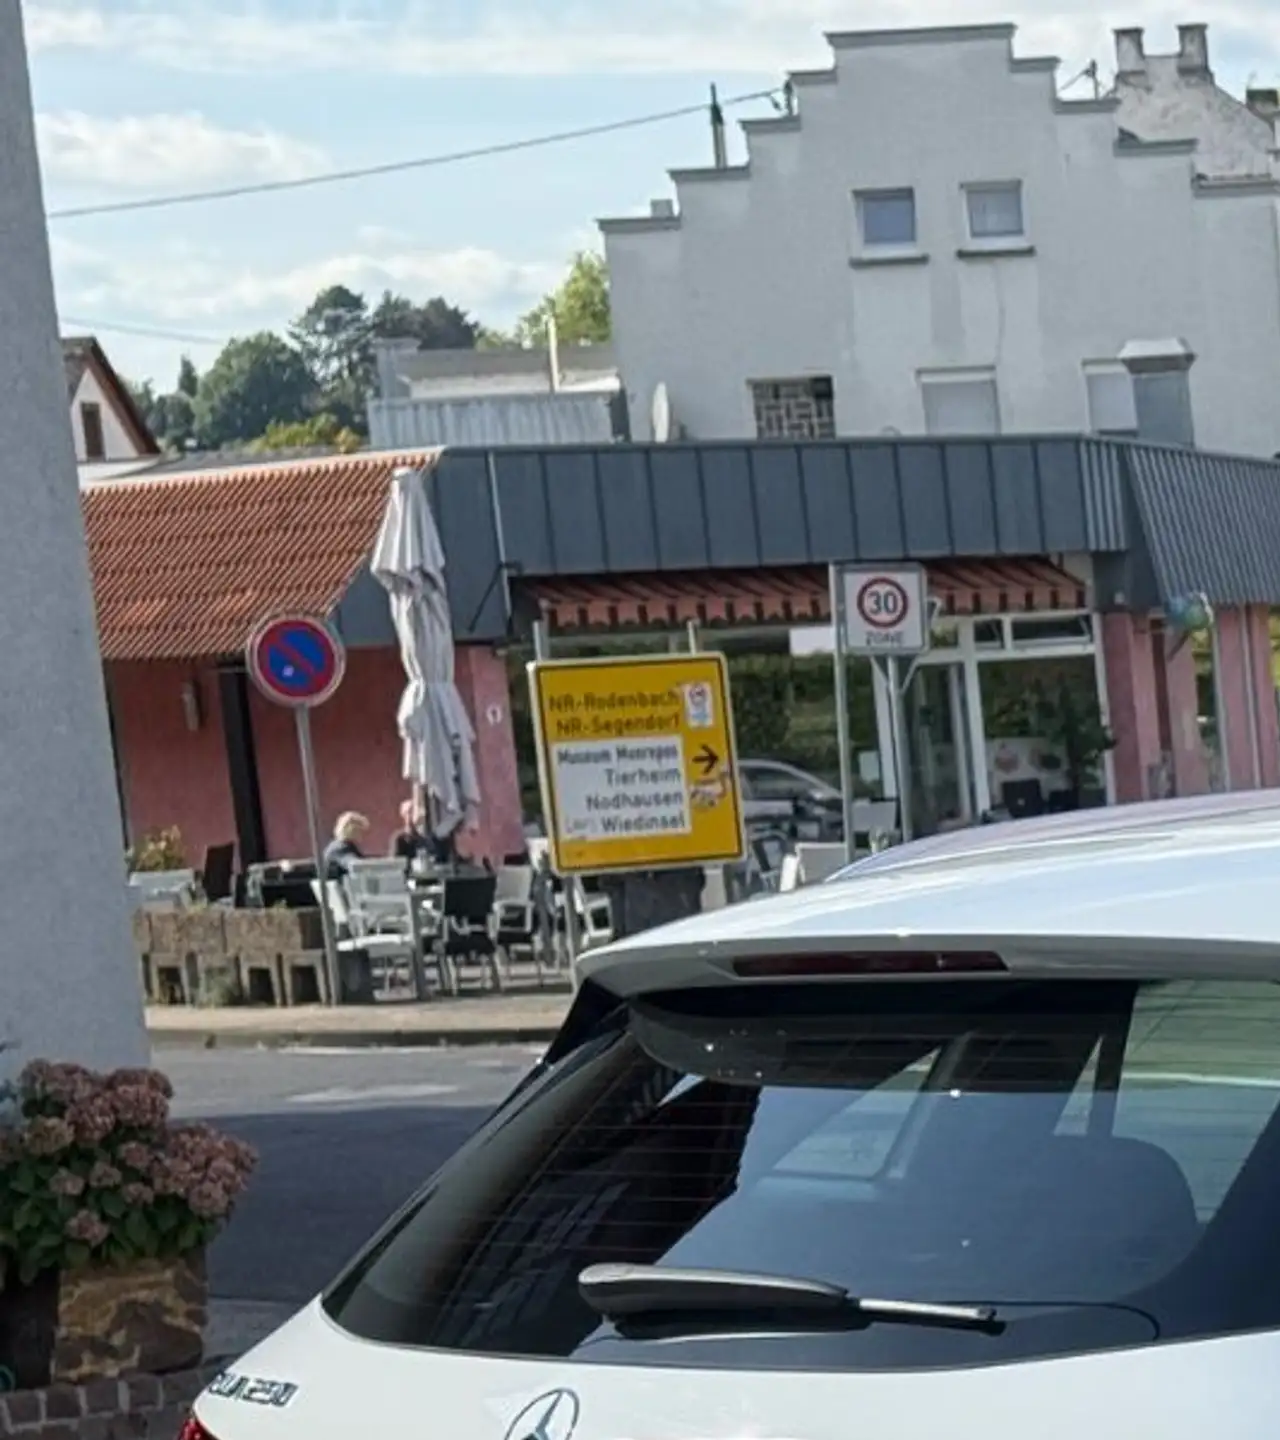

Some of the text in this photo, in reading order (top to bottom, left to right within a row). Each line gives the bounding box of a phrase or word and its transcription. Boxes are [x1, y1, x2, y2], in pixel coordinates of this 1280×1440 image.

[867, 590, 898, 616] 30
[604, 766, 682, 787] Tierheim
[585, 789, 684, 812] Nodhausen
